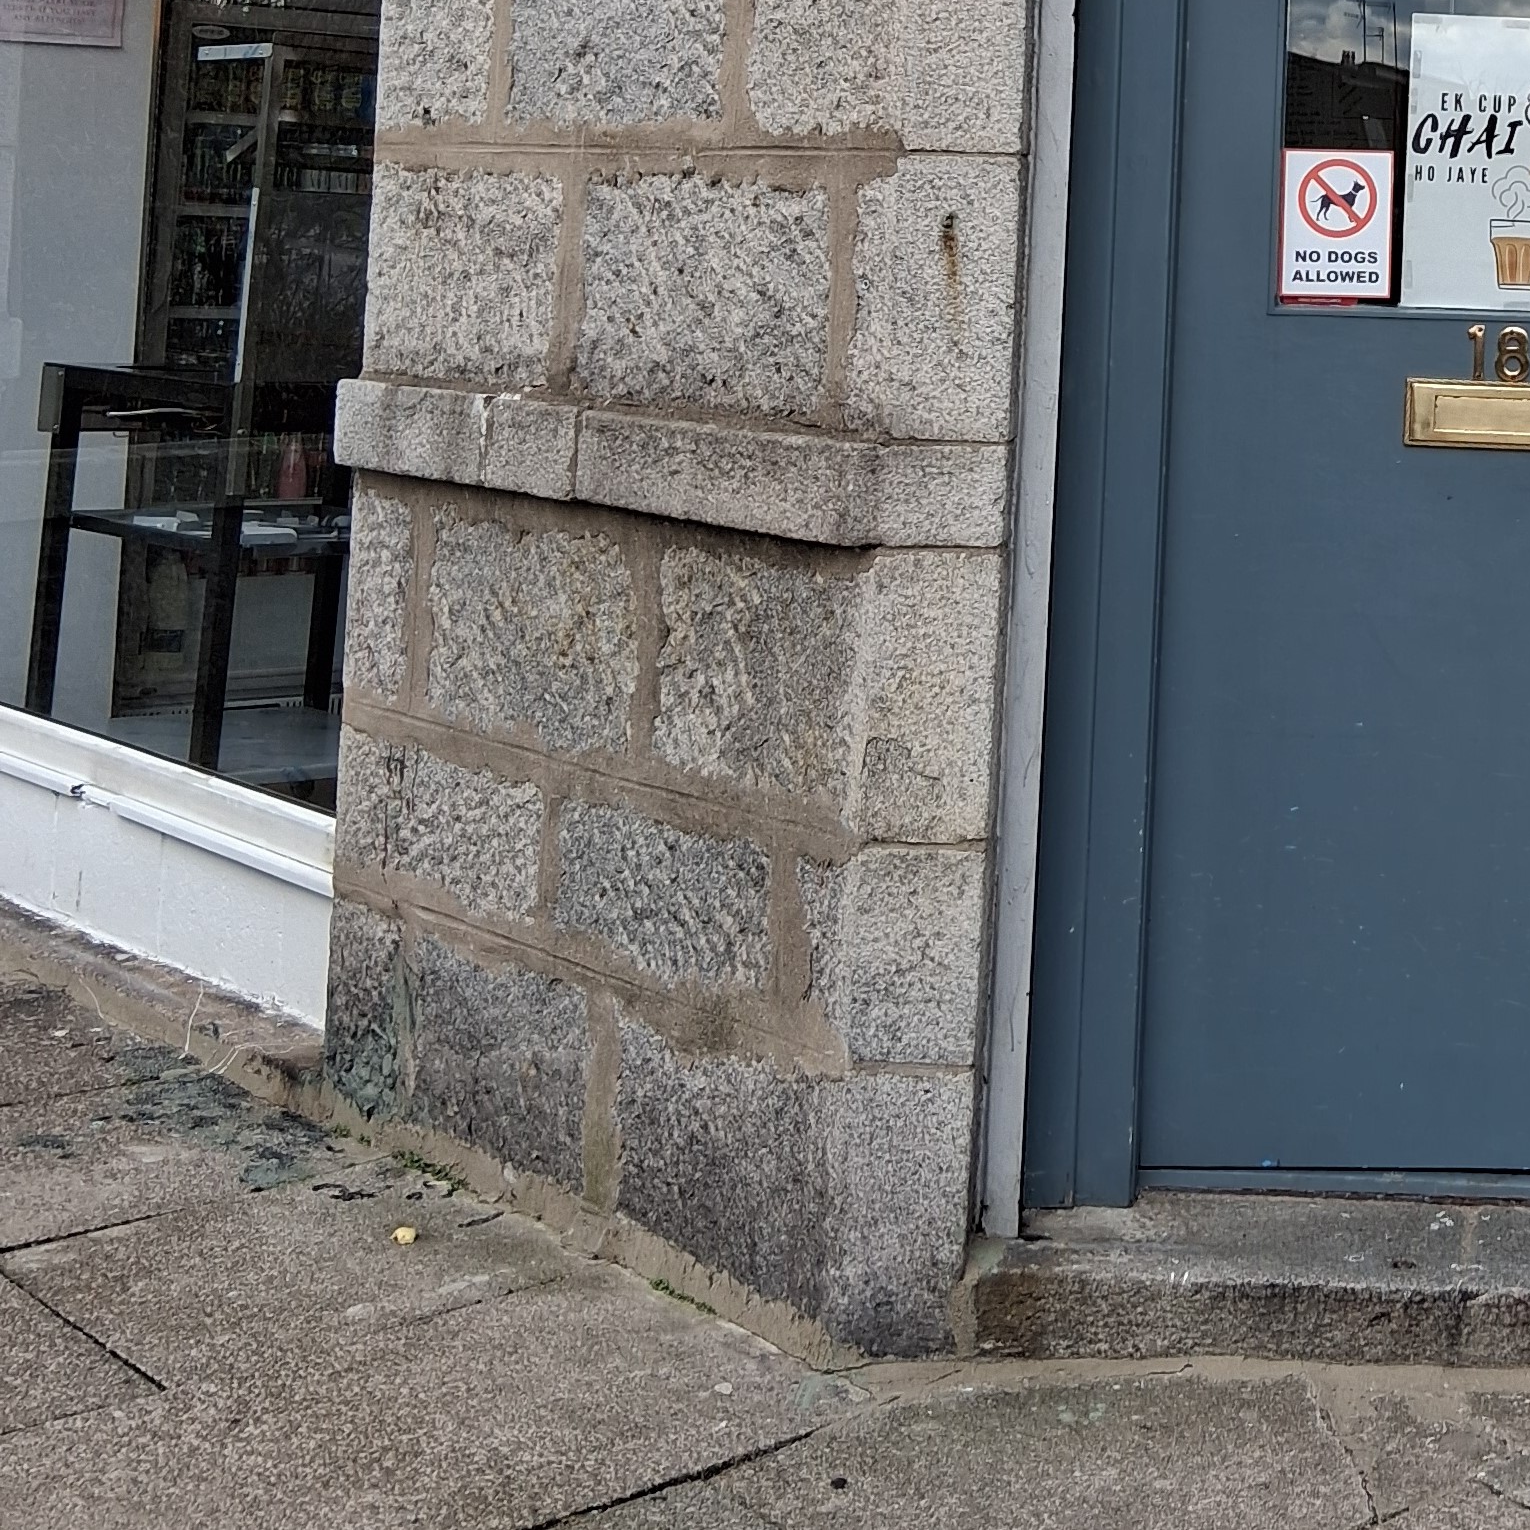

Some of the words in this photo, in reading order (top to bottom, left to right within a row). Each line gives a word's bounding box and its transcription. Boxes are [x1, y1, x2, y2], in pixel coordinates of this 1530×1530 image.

[1441, 92, 1463, 112] EK
[1478, 93, 1517, 114] CUP
[1411, 113, 1524, 160] CHAI
[1414, 165, 1435, 182] HO
[1447, 166, 1489, 184] JAYE
[1295, 250, 1321, 263] NO
[1327, 250, 1378, 264] DOGS
[1292, 269, 1380, 284] ALLOWED
[1467, 323, 1530, 382] 18
